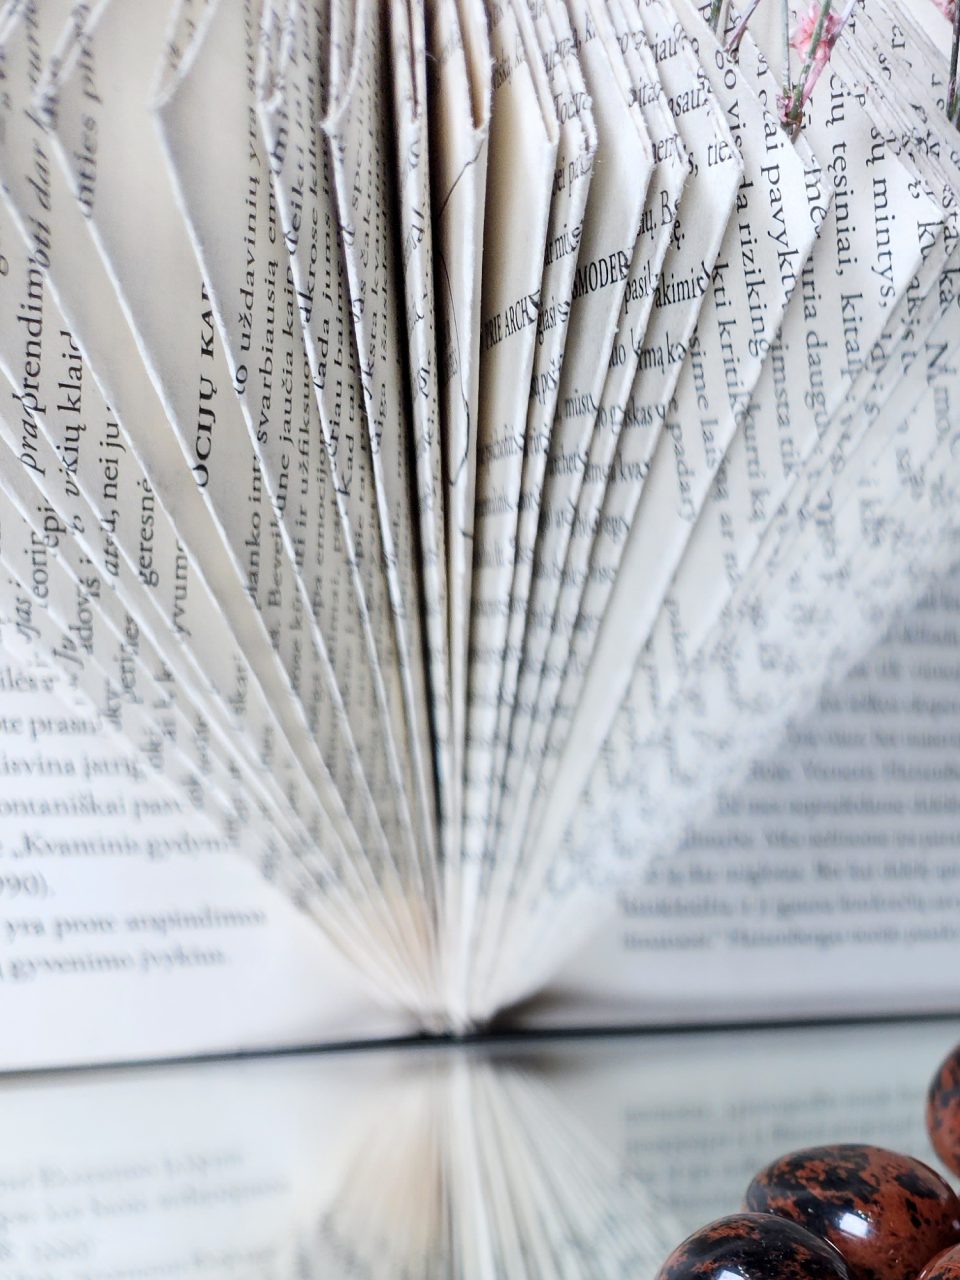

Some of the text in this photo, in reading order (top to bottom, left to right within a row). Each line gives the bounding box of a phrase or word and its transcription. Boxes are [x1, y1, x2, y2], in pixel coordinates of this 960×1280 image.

[239, 175, 260, 352] uždavinių
[827, 141, 858, 277] tęsiniai,
[870, 177, 898, 309] mintys,
[257, 259, 279, 445] svarbiausią
[738, 222, 772, 359] riziking
[98, 456, 121, 501] nei
